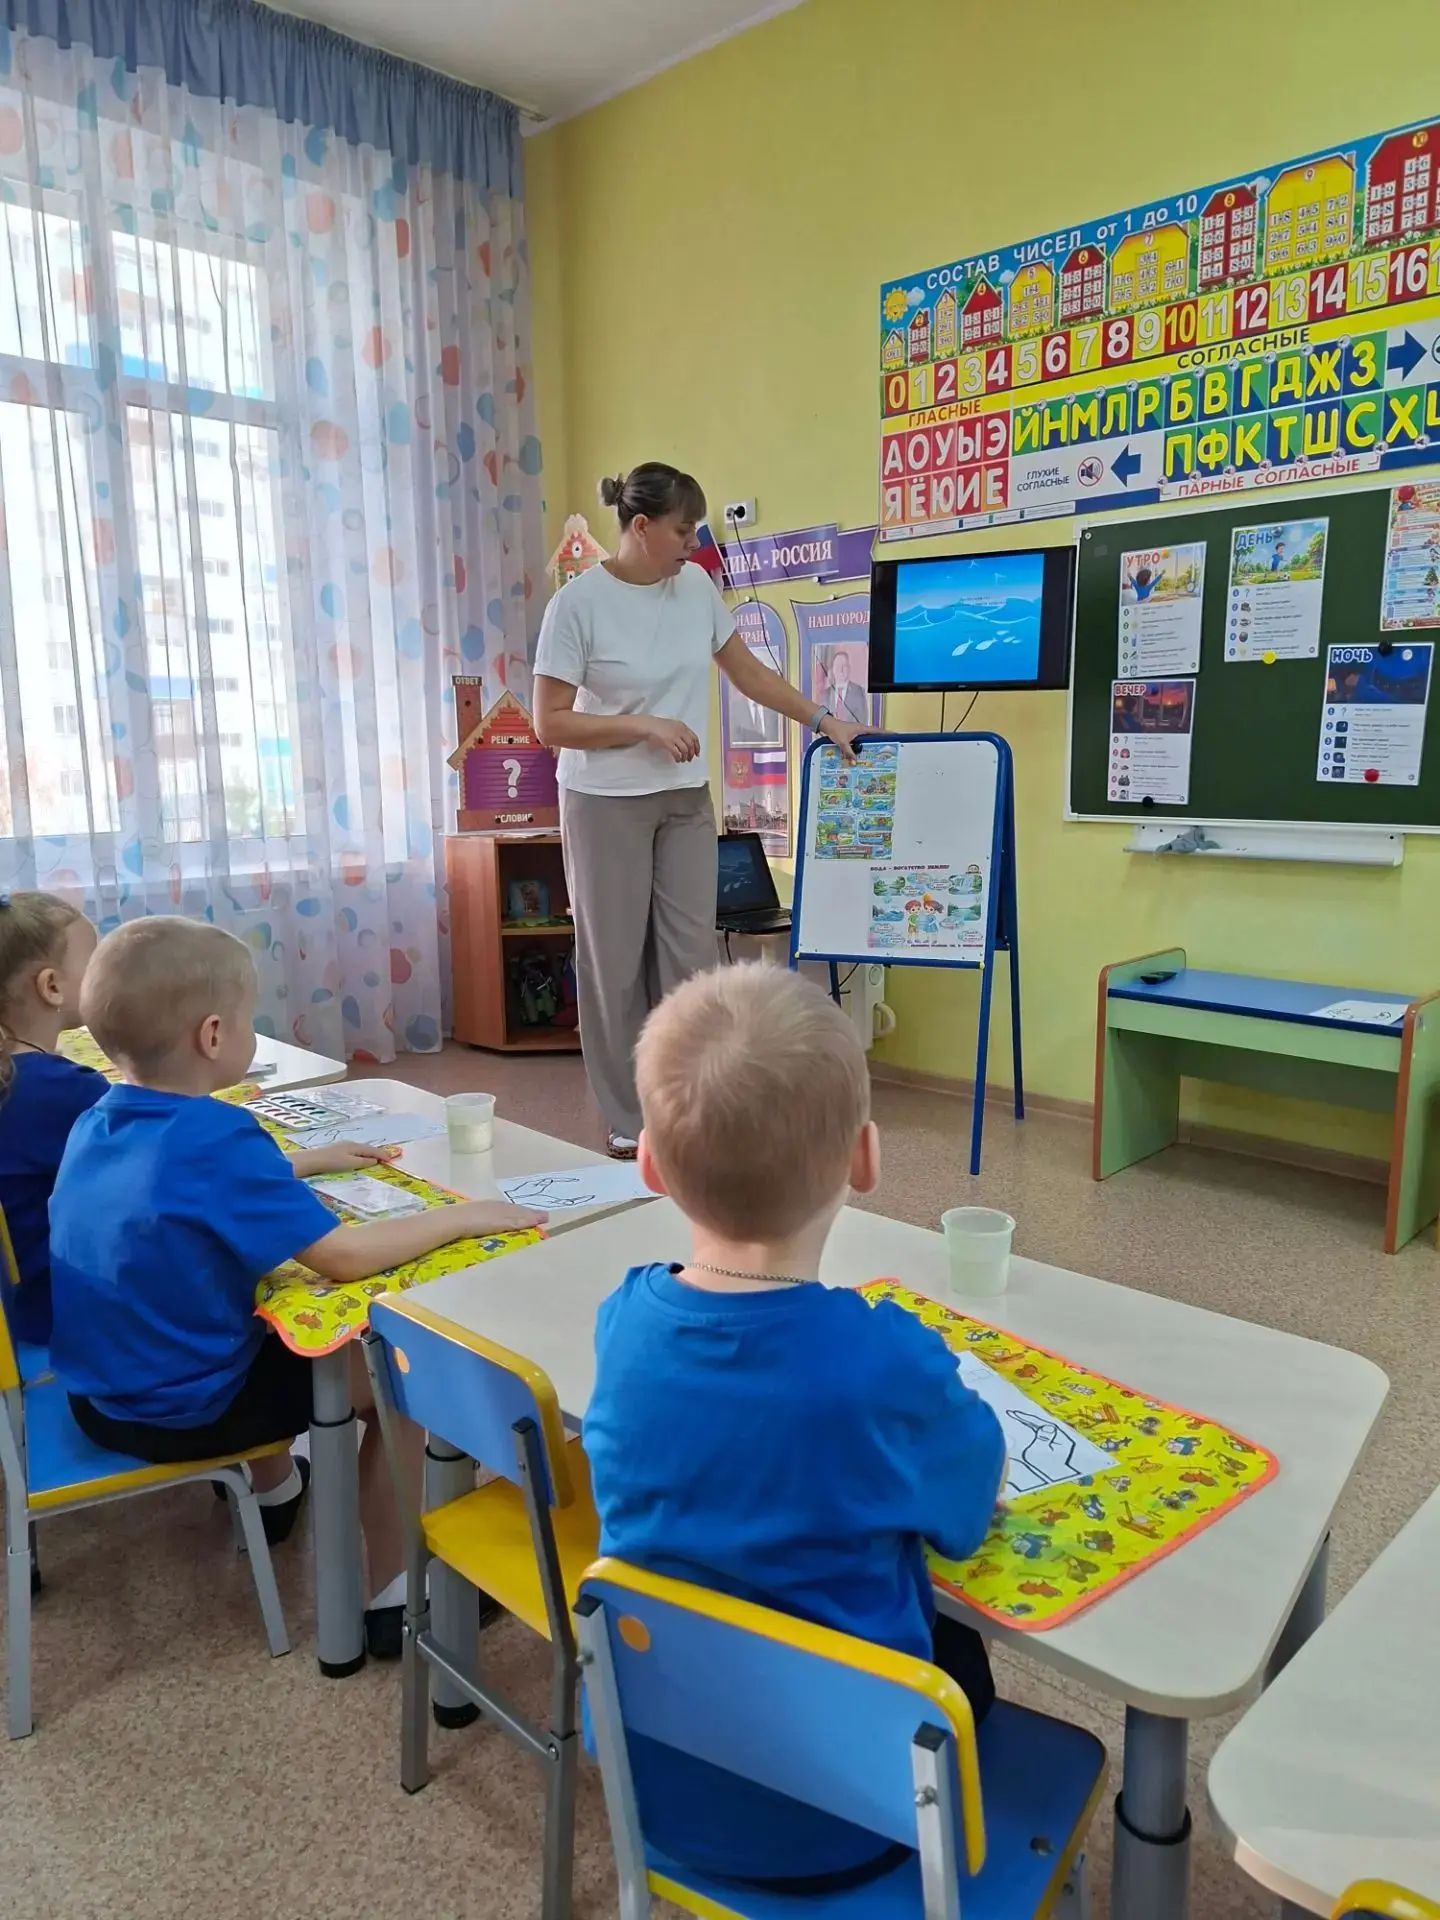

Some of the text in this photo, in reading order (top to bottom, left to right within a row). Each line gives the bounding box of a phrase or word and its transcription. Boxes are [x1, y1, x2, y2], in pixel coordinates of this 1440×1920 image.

[926, 195, 1198, 290] СОСТАВ ЧИСЕЛ от 1 до 10
[889, 376, 906, 409] 0
[914, 370, 926, 404] 1
[937, 364, 955, 400] 2
[964, 357, 982, 392] 3
[988, 350, 1008, 385] 4
[1018, 343, 1037, 379] 5
[1045, 336, 1066, 372] 6
[1077, 328, 1096, 367] 7
[1107, 320, 1130, 358] 8
[1137, 312, 1160, 351] 9
[1166, 304, 1196, 346] 10
[1202, 295, 1227, 337] 11
[1236, 286, 1268, 330] 12
[1273, 277, 1307, 321] 13
[1311, 267, 1346, 313] 14
[1350, 257, 1386, 304] 15
[1391, 248, 1428, 295] 16
[1177, 328, 1310, 368] СОГЛАСНЫЕ
[909, 399, 981, 427] ГЛАСНЫЕ
[1027, 467, 1060, 480] ГЛУХИЕ
[1178, 458, 1360, 497] ПАРНЫЕ СОГЛАСНЫЕ
[1017, 476, 1070, 492] СОГЛАСНЫЕ
[1237, 533, 1273, 549] ДЕНЬ
[771, 540, 833, 568] РОССИЯ
[1126, 552, 1160, 567] УТРО
[808, 610, 870, 628] НАШ ГОРОД
[1332, 648, 1373, 663] НОЧЬ
[455, 677, 479, 685] ОТВЕТ
[1115, 685, 1146, 696] ВЕЧЕР
